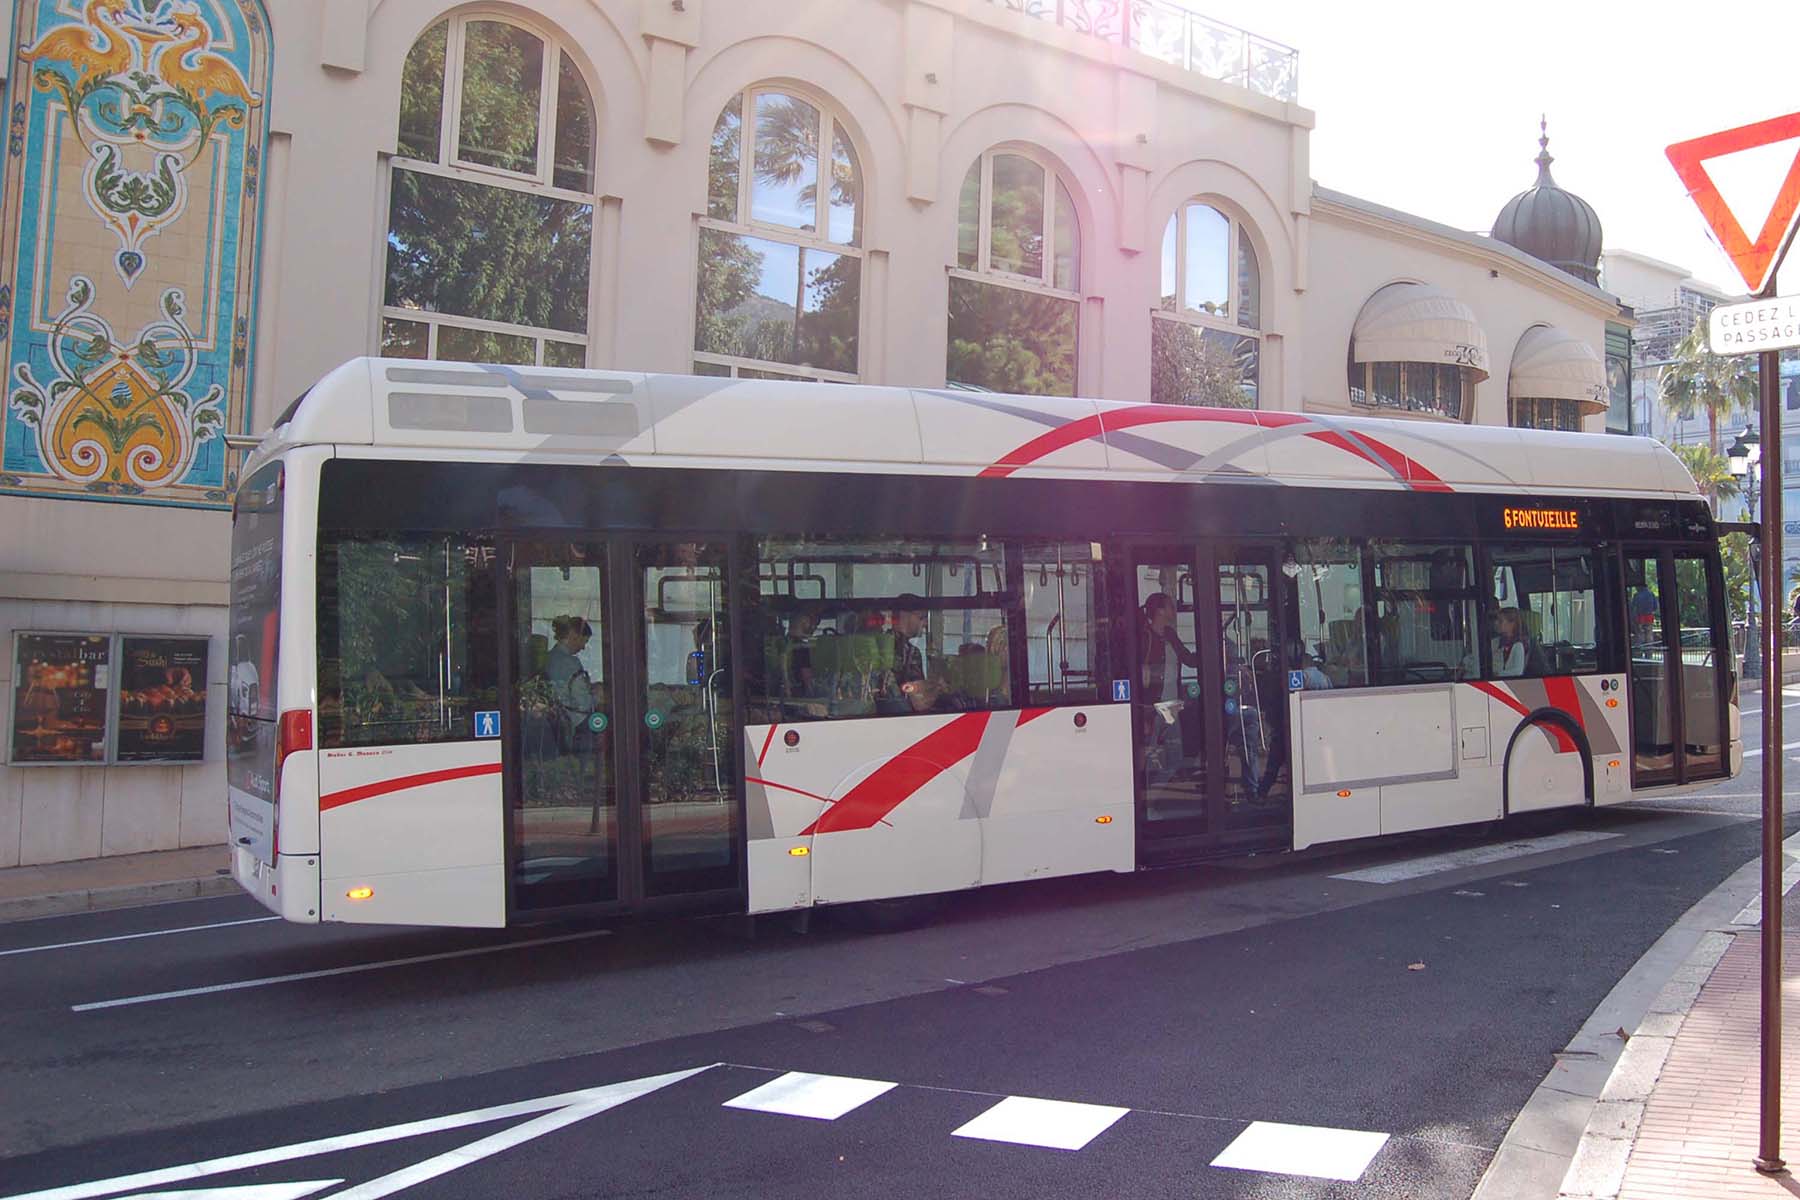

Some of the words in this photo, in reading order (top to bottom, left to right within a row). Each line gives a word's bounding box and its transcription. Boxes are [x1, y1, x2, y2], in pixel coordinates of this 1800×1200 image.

[1720, 307, 1779, 328] CEDEZ
[1723, 324, 1800, 345] PASSAG
[1503, 507, 1512, 529] 6
[1512, 509, 1578, 529] FONTVIEILLE
